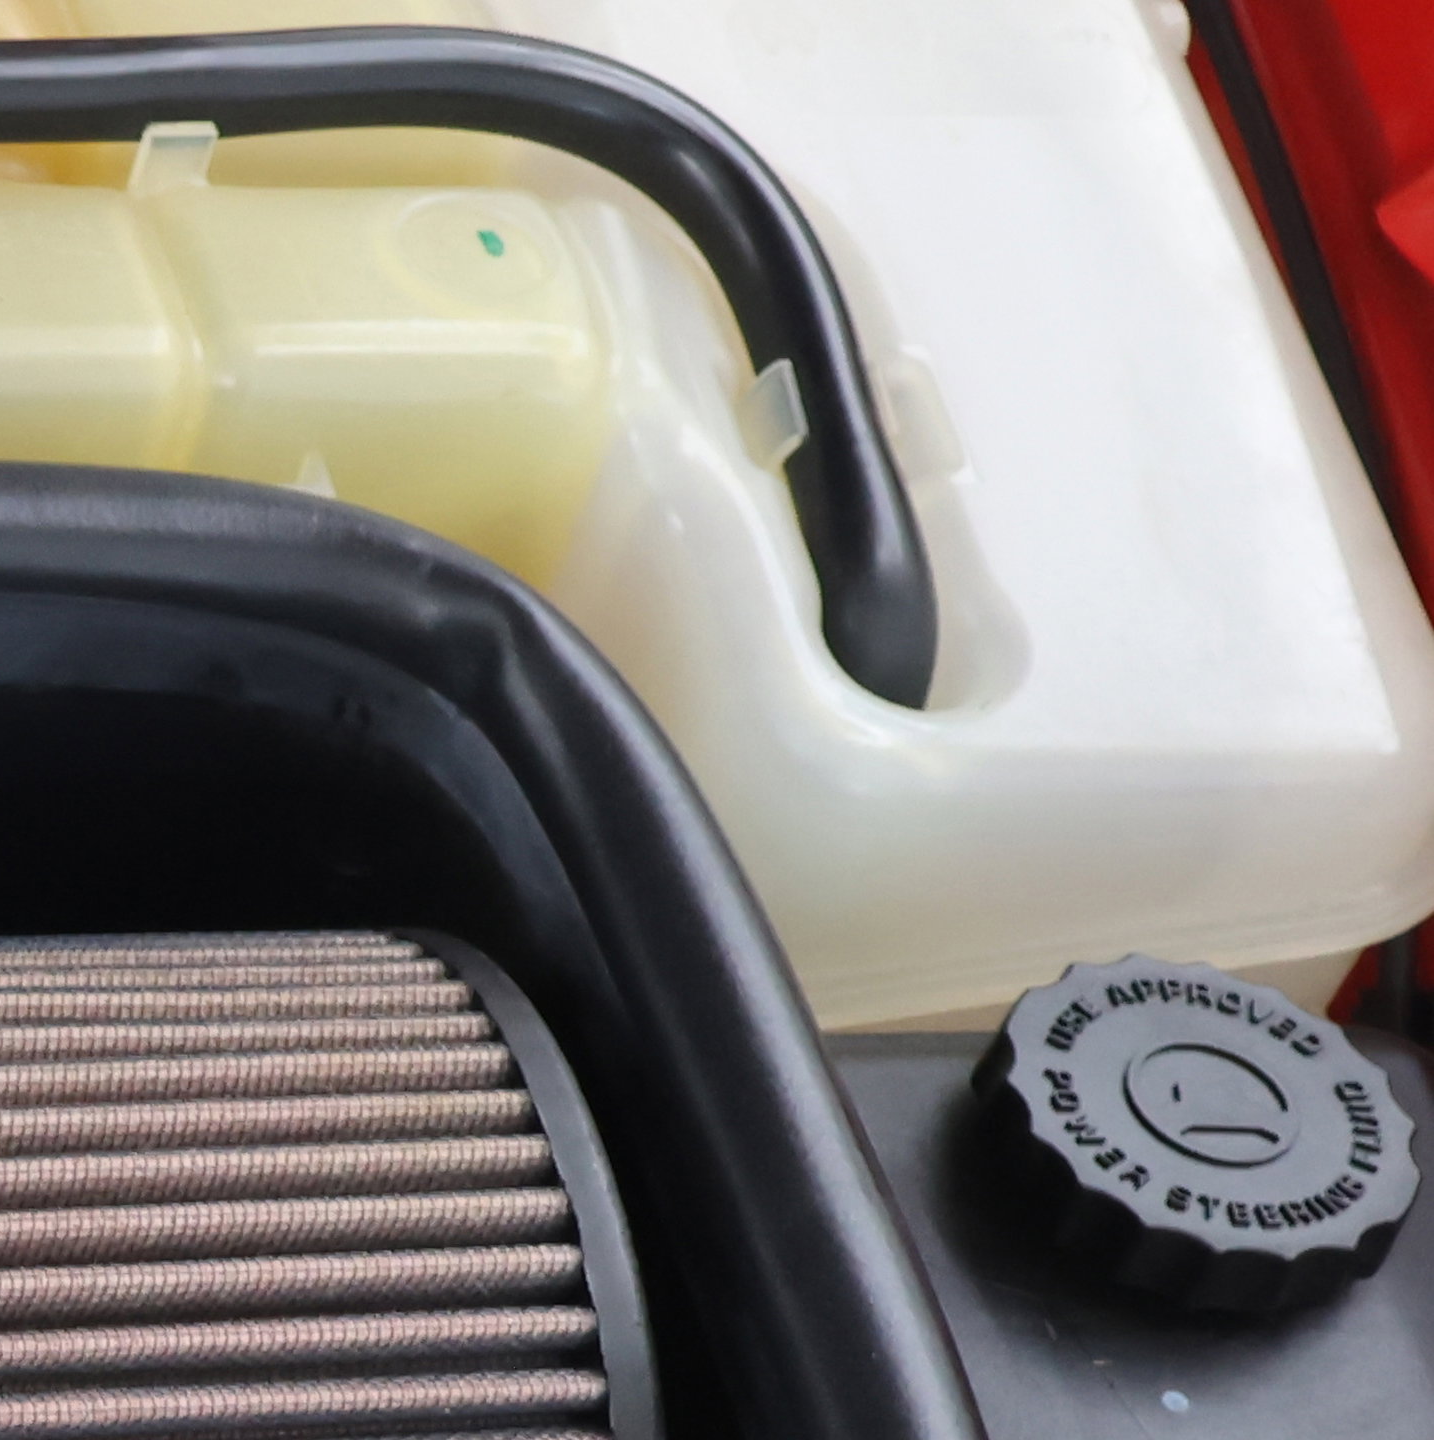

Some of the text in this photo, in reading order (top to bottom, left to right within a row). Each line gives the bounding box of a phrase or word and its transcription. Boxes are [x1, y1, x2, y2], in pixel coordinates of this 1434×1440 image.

[1044, 977, 1326, 1058] USE APPROVED
[1043, 1067, 1150, 1192] POWER
[1165, 1173, 1367, 1231] STEERING
